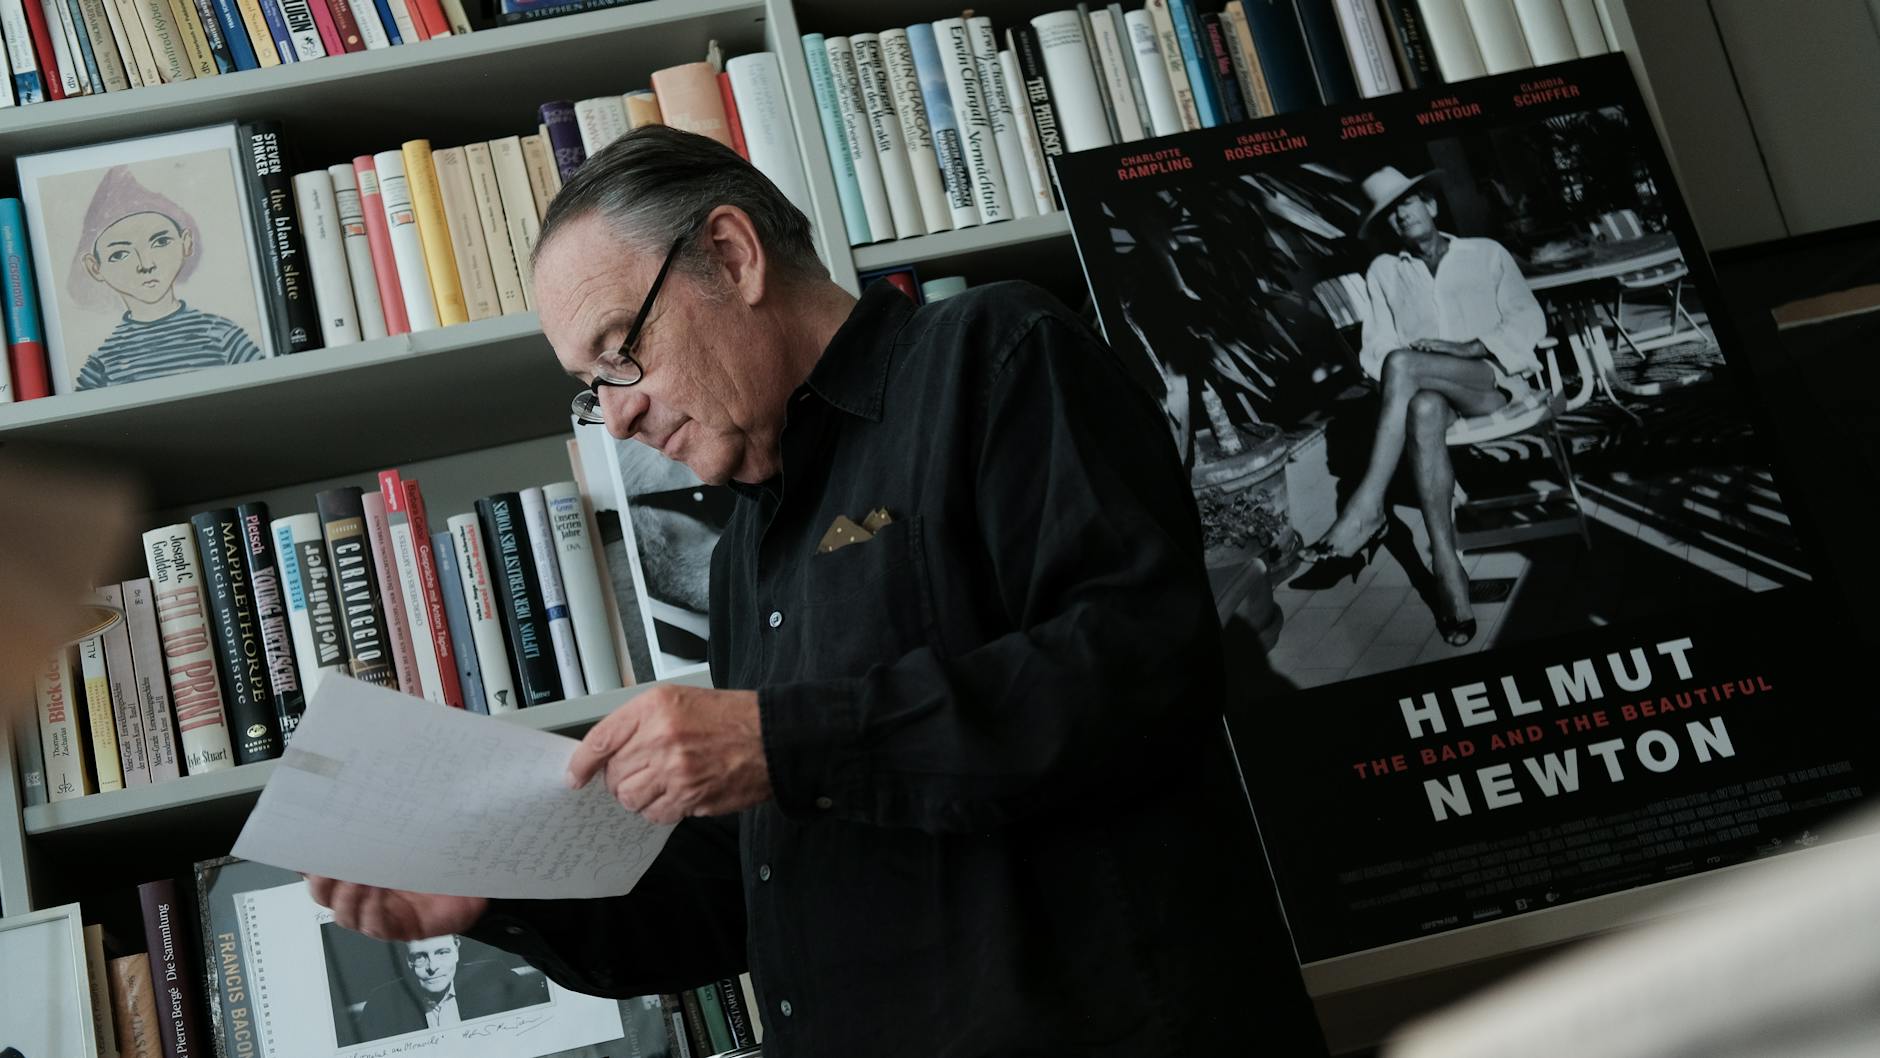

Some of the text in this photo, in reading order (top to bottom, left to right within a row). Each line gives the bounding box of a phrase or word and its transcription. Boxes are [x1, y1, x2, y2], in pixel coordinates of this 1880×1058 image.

[150, 0, 181, 78] Manfred Kyber
[200, 61, 211, 74] dtv
[867, 38, 896, 118] Erwin Chargaff
[947, 24, 989, 131] Erwin Chargaff
[977, 23, 1012, 116] Erwin Chargaff
[1520, 76, 1564, 93] CLAUDIA
[854, 39, 892, 153] Das Feuer des Heraklit
[894, 33, 931, 151] ERWIN CHARGAFF
[972, 52, 1006, 135] Zeugenschaft
[1026, 76, 1048, 103] THE
[1430, 96, 1460, 110] ANNA
[1513, 84, 1581, 108] SCHIFFER
[1033, 102, 1064, 159] PHILOSOP
[1340, 112, 1376, 128] GRACE
[1340, 121, 1385, 141] JONES
[1416, 103, 1482, 126] WINTOUR
[252, 134, 269, 177] PINKER
[263, 133, 282, 174] STEVEN
[1121, 147, 1182, 168] CHARLOTTE
[1224, 135, 1308, 162] ROSSELLINI
[1236, 128, 1287, 146] ISABELLA
[964, 129, 1002, 218] Vermächtnis
[1118, 157, 1194, 182] RAMPLING
[270, 188, 300, 300] the blank slate
[10, 254, 24, 307] Casanova
[407, 483, 421, 515] Barbara
[554, 513, 580, 523] Unsere
[557, 521, 582, 531] letzten
[562, 529, 581, 540] Jahre
[152, 541, 169, 583] Goulden
[169, 535, 194, 584] Joseph C.
[418, 544, 436, 588] Gespräche
[466, 522, 493, 619] Marcel Reich-Ranicki
[493, 500, 541, 660] LIFTON DER VERLUST DES TODES
[203, 525, 246, 704] patricia morrisroe
[221, 522, 265, 703] MAPPLETHORPE
[246, 514, 298, 696] Pletsch YOUNG NIETZSCHE
[304, 544, 340, 663] Weltbürger
[336, 542, 382, 662] CARAVAGGIO
[428, 589, 438, 602] mit
[430, 602, 444, 630] Antoni
[87, 637, 96, 659] ALL
[163, 623, 208, 658] TO
[47, 686, 66, 724] Blick
[169, 659, 225, 734] PRINT
[1399, 637, 1693, 739] HELMUT
[62, 727, 70, 757] Zacharias
[244, 738, 272, 749] RANDOM
[1353, 675, 1774, 781] THE BAD AND THE BEAUTIFUL
[122, 741, 134, 772] Meier-Graefe
[151, 736, 163, 767] Meier-Graefe
[202, 748, 228, 765] Stuart
[249, 744, 271, 754] HOUSE
[1423, 715, 1736, 822] NEWTON
[158, 903, 187, 1055] Pierre Bergé Die Sammlung
[218, 932, 245, 1004] FRANCIS
